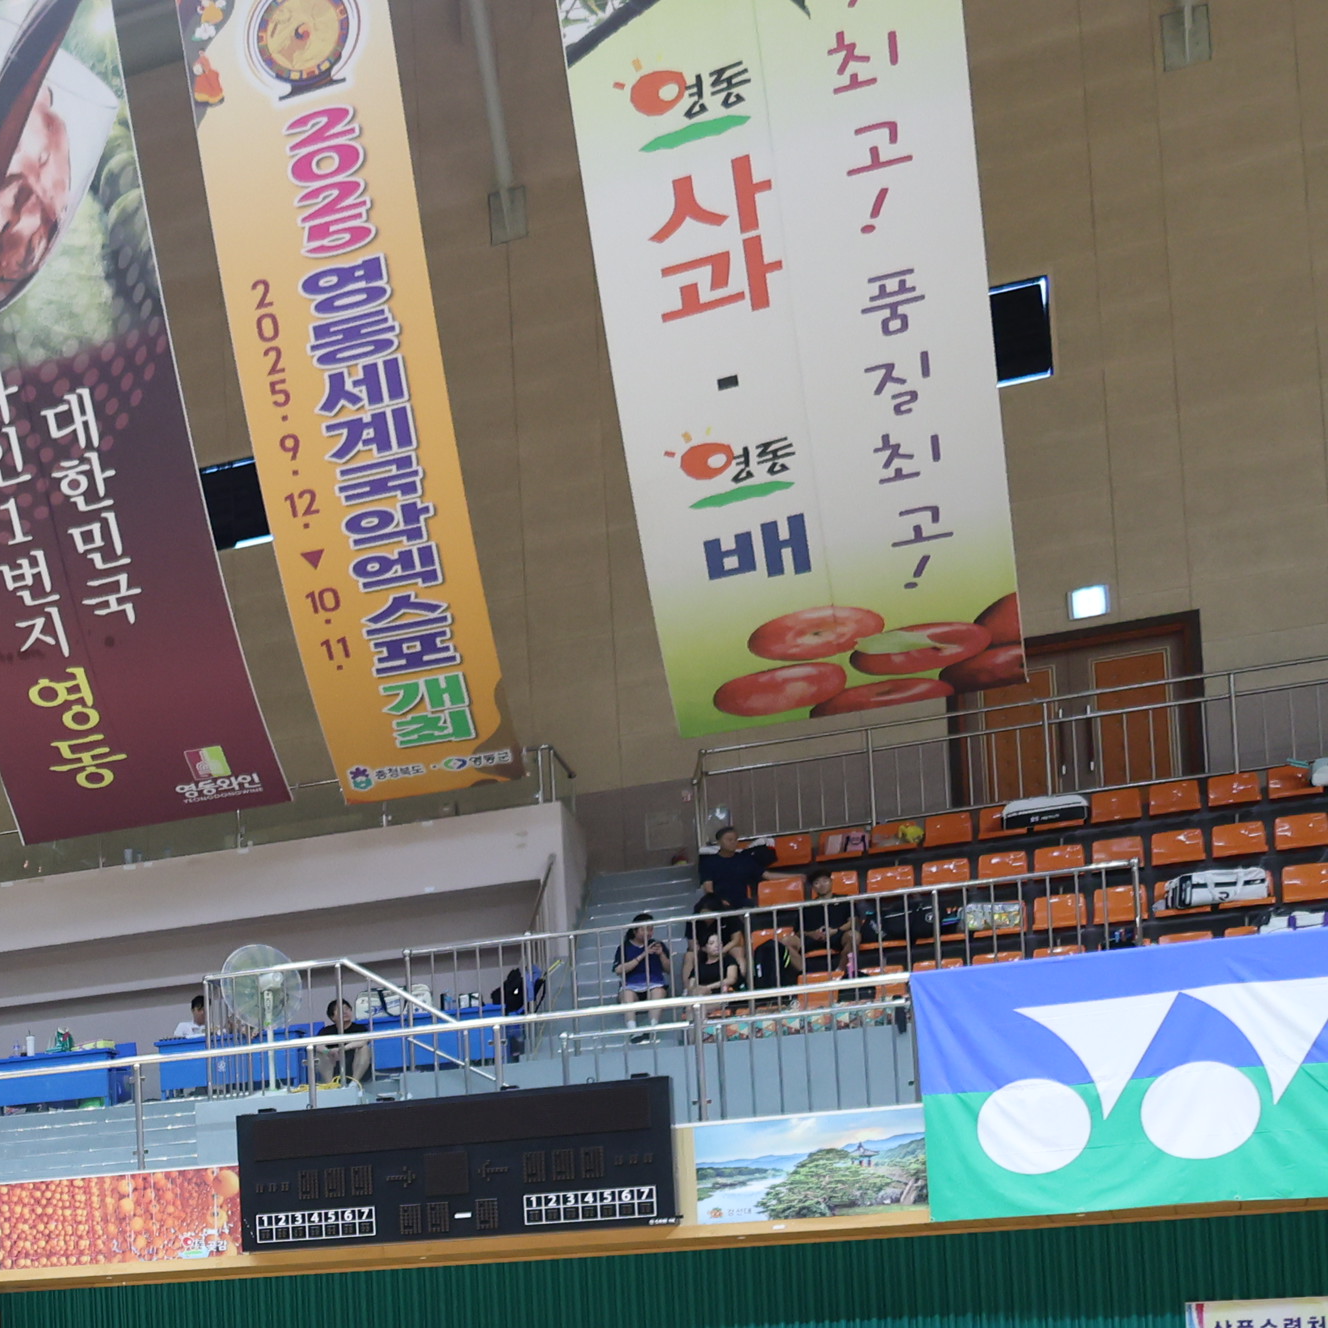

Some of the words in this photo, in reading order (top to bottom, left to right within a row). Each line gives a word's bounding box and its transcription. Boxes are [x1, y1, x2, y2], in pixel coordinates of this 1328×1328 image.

[630, 60, 751, 120] 영동
[647, 154, 784, 323] 사과
[282, 105, 378, 258] 2025
[380, 672, 478, 749] 개최
[680, 436, 796, 484] 영동
[40, 388, 142, 628] 대한민국
[703, 512, 812, 581] 배
[28, 666, 127, 790] 영동
[176, 772, 261, 798] 영동와인
[469, 750, 511, 767] 영동군
[262, 1216, 269, 1227] 1
[278, 1215, 286, 1226] 2
[295, 1214, 303, 1225] 3
[310, 1212, 319, 1224] 4
[328, 1211, 336, 1222] 5
[344, 1210, 352, 1221] 6
[361, 1209, 370, 1220] 7
[530, 1197, 537, 1208] 1
[547, 1195, 556, 1207] 2
[566, 1194, 575, 1206] 3
[584, 1193, 594, 1204] 4
[603, 1191, 612, 1203] 5
[622, 1190, 631, 1201] 6
[640, 1188, 649, 1200] 7
